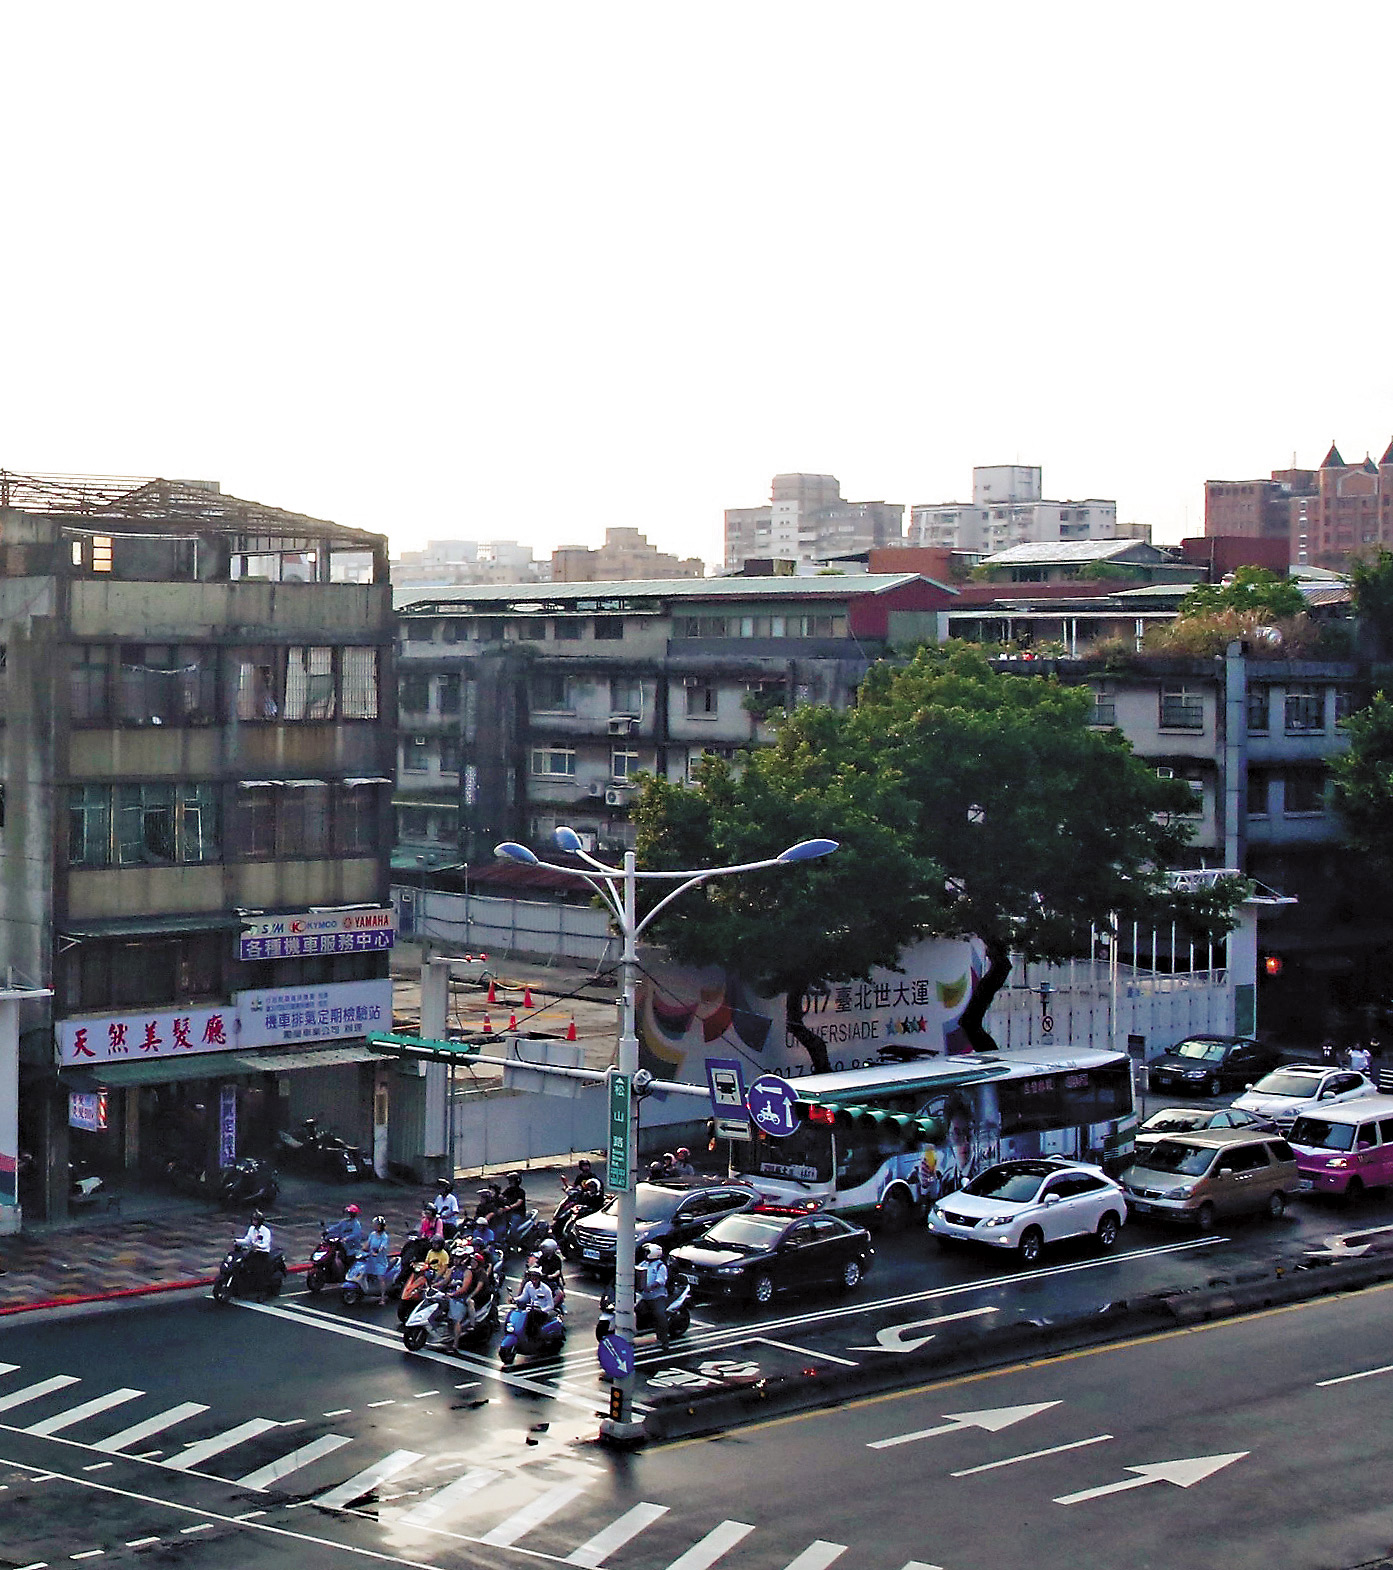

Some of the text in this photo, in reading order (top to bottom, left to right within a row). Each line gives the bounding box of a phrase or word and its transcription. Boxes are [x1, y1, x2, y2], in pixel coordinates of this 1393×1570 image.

[307, 920, 338, 930] KYMCO
[355, 914, 389, 928] YAMAHA
[246, 931, 390, 958] 各種機車服務中心
[835, 980, 929, 1013] 臺北世大運
[265, 1005, 381, 1030] 機車排氣定期檢驗站
[73, 1014, 227, 1058] 天然美髮廳
[613, 1084, 625, 1148] 松山路
